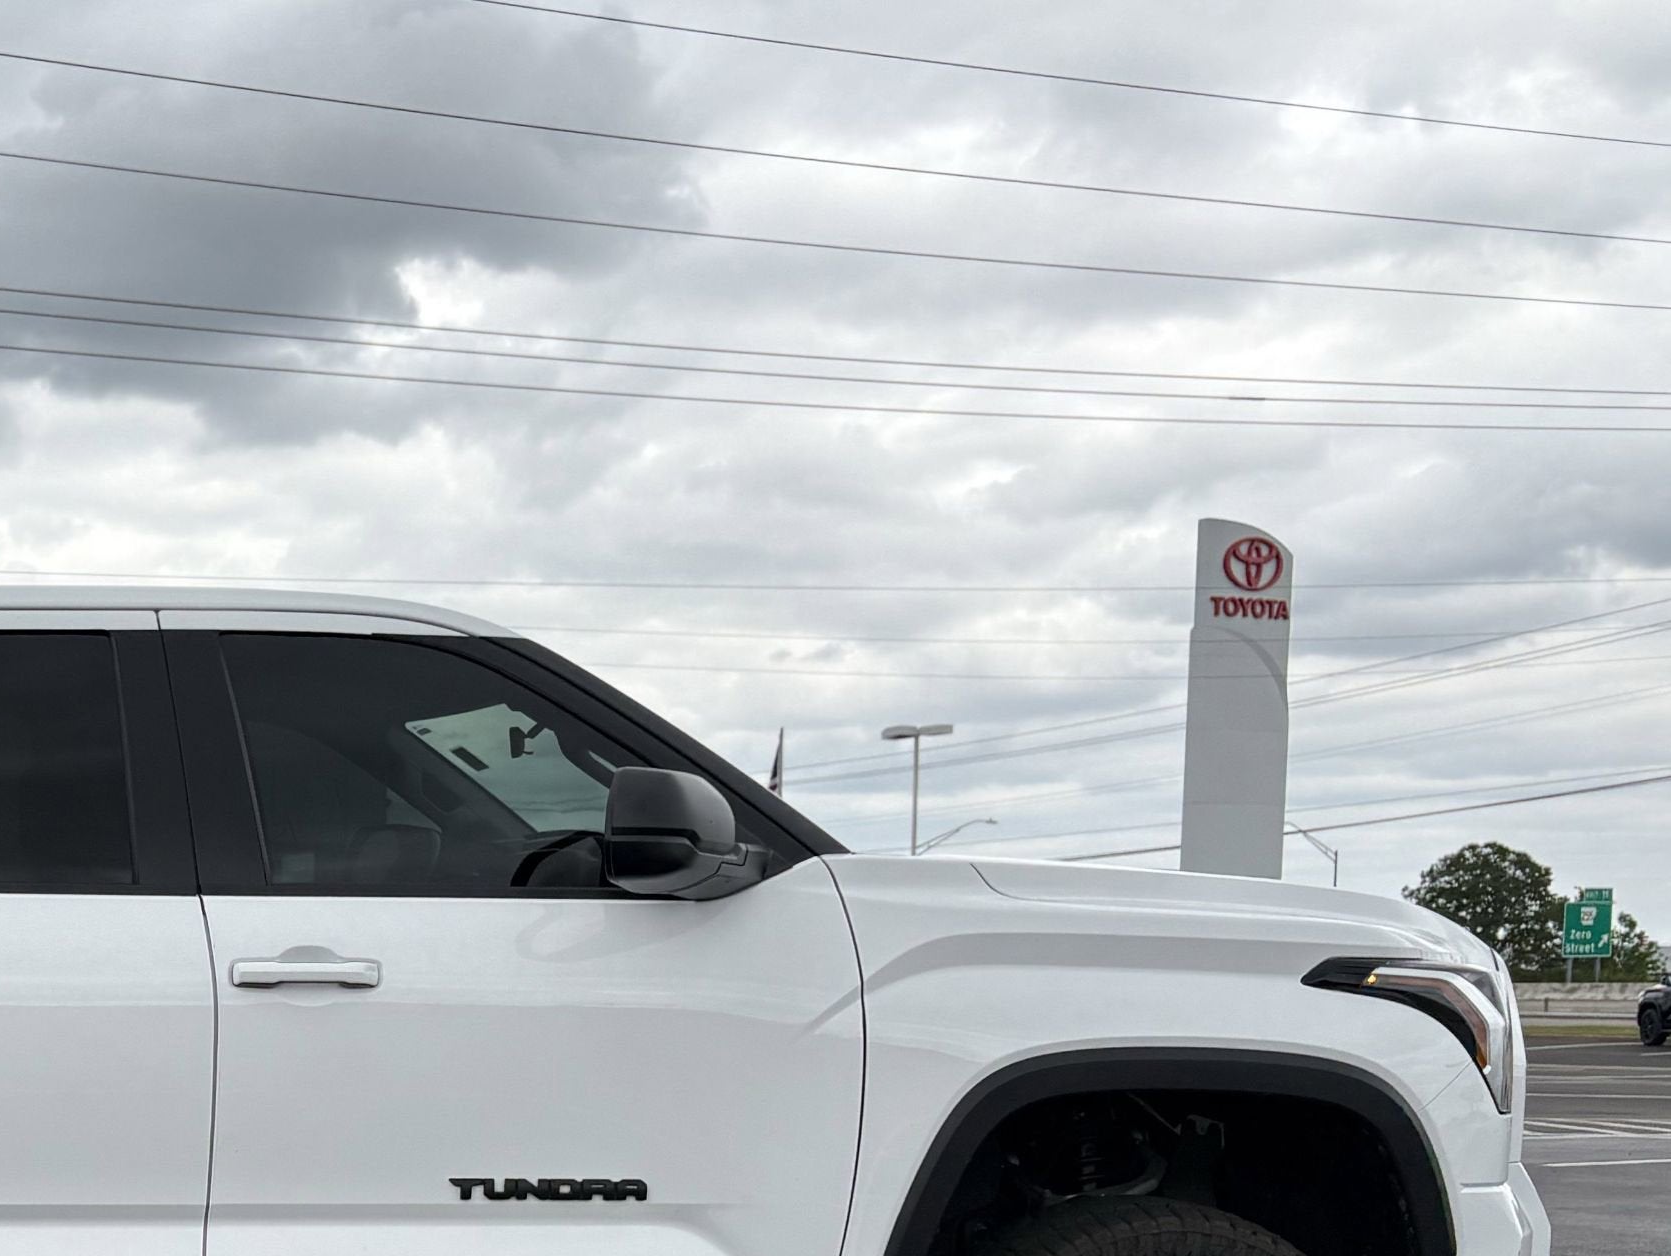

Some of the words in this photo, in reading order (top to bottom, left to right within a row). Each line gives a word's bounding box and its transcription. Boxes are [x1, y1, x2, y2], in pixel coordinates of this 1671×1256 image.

[1210, 596, 1290, 620] TOYOTA
[1569, 928, 1592, 940] Zero
[1564, 942, 1596, 953] Street
[448, 1178, 648, 1201] TUNDRA
